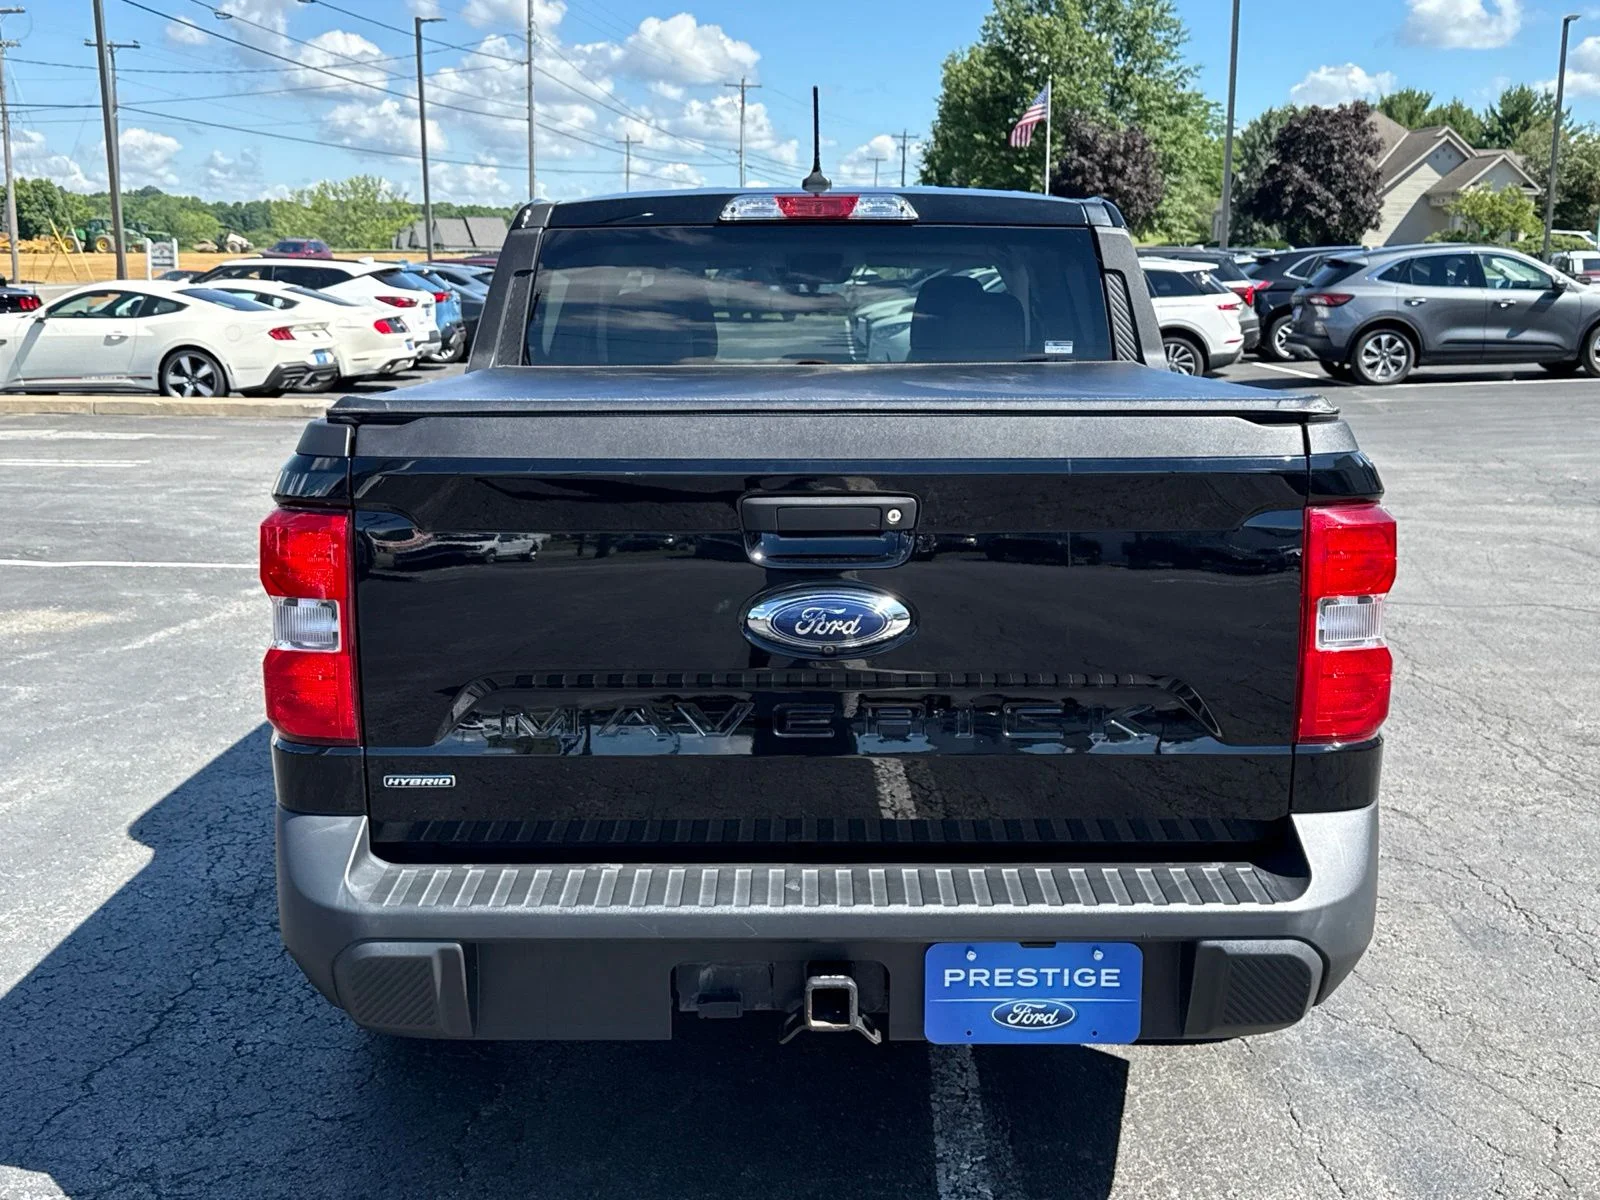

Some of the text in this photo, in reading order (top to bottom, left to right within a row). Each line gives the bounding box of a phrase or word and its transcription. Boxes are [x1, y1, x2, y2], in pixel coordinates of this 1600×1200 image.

[795, 607, 862, 635] Ford
[502, 703, 1155, 738] MAVERICK
[387, 778, 451, 786] HYBRID
[944, 968, 1121, 987] PRESTIGE
[1006, 1002, 1058, 1025] Ford
